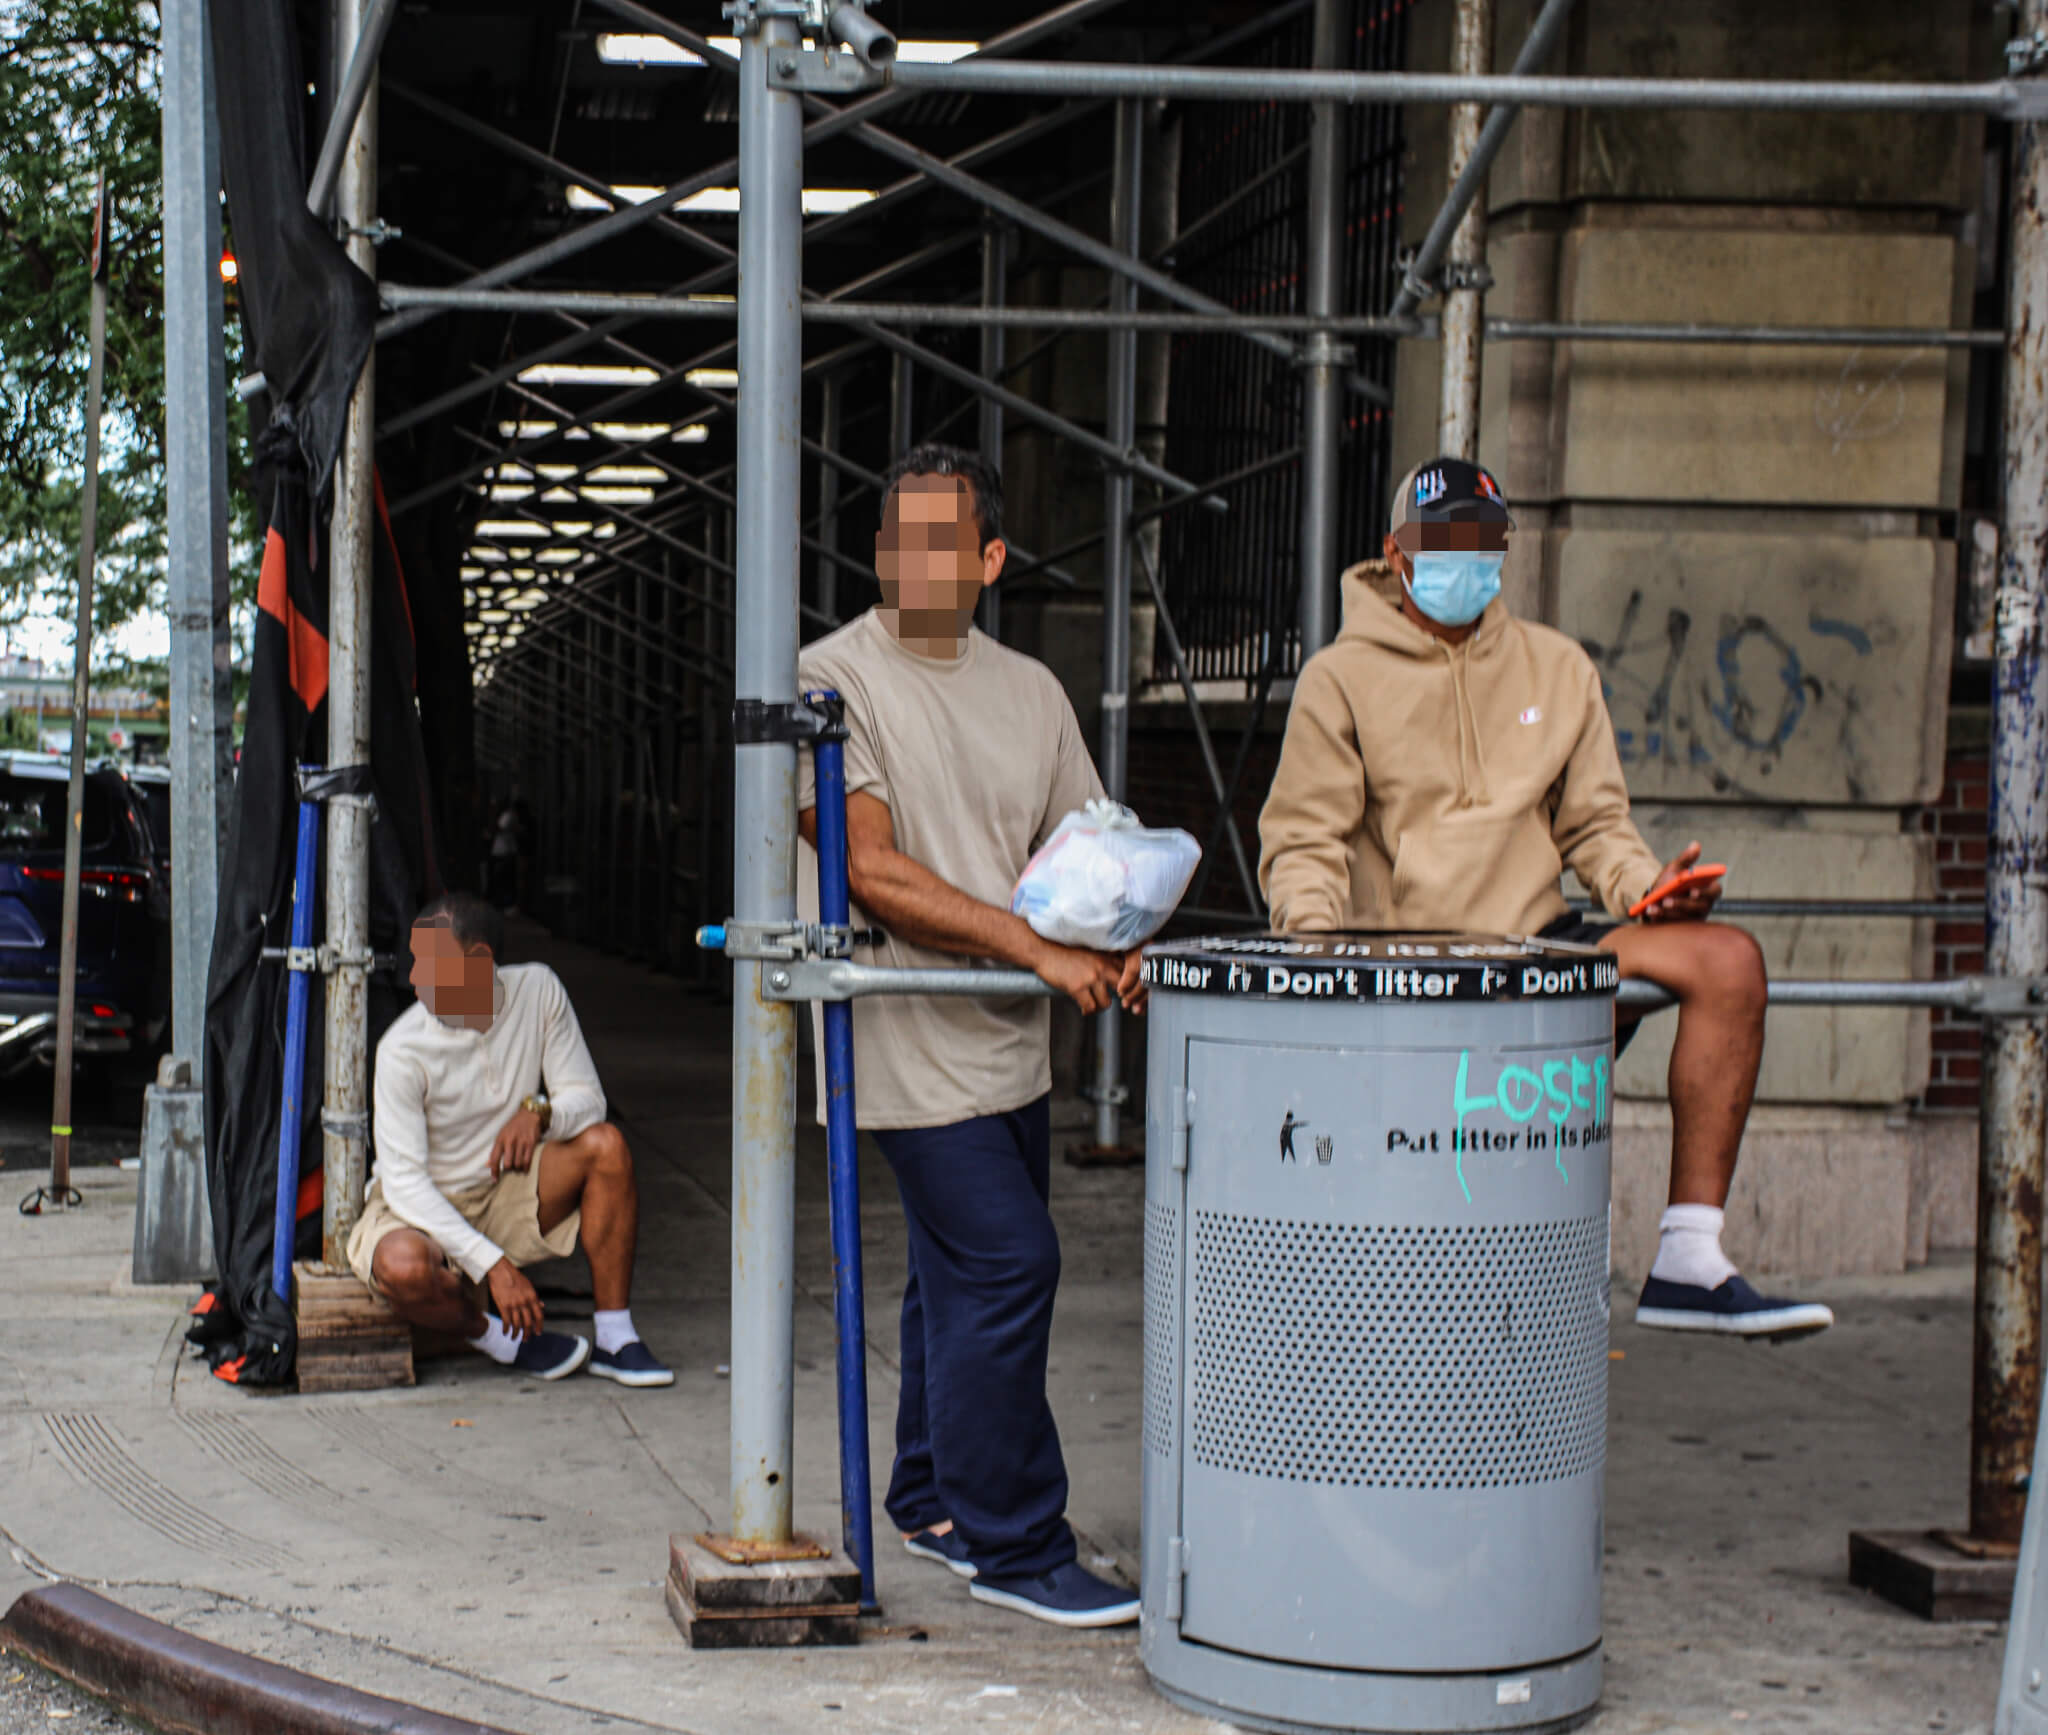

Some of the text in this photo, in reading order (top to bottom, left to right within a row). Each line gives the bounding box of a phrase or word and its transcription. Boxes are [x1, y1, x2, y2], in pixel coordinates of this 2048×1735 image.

[1163, 958, 1212, 990] litter
[1267, 966, 1359, 996] Don't
[1375, 966, 1460, 997] litter
[1522, 965, 1588, 995] Don't
[1387, 1128, 1440, 1152] Put
[1453, 1128, 1520, 1152] litter
[1527, 1125, 1547, 1150] in
